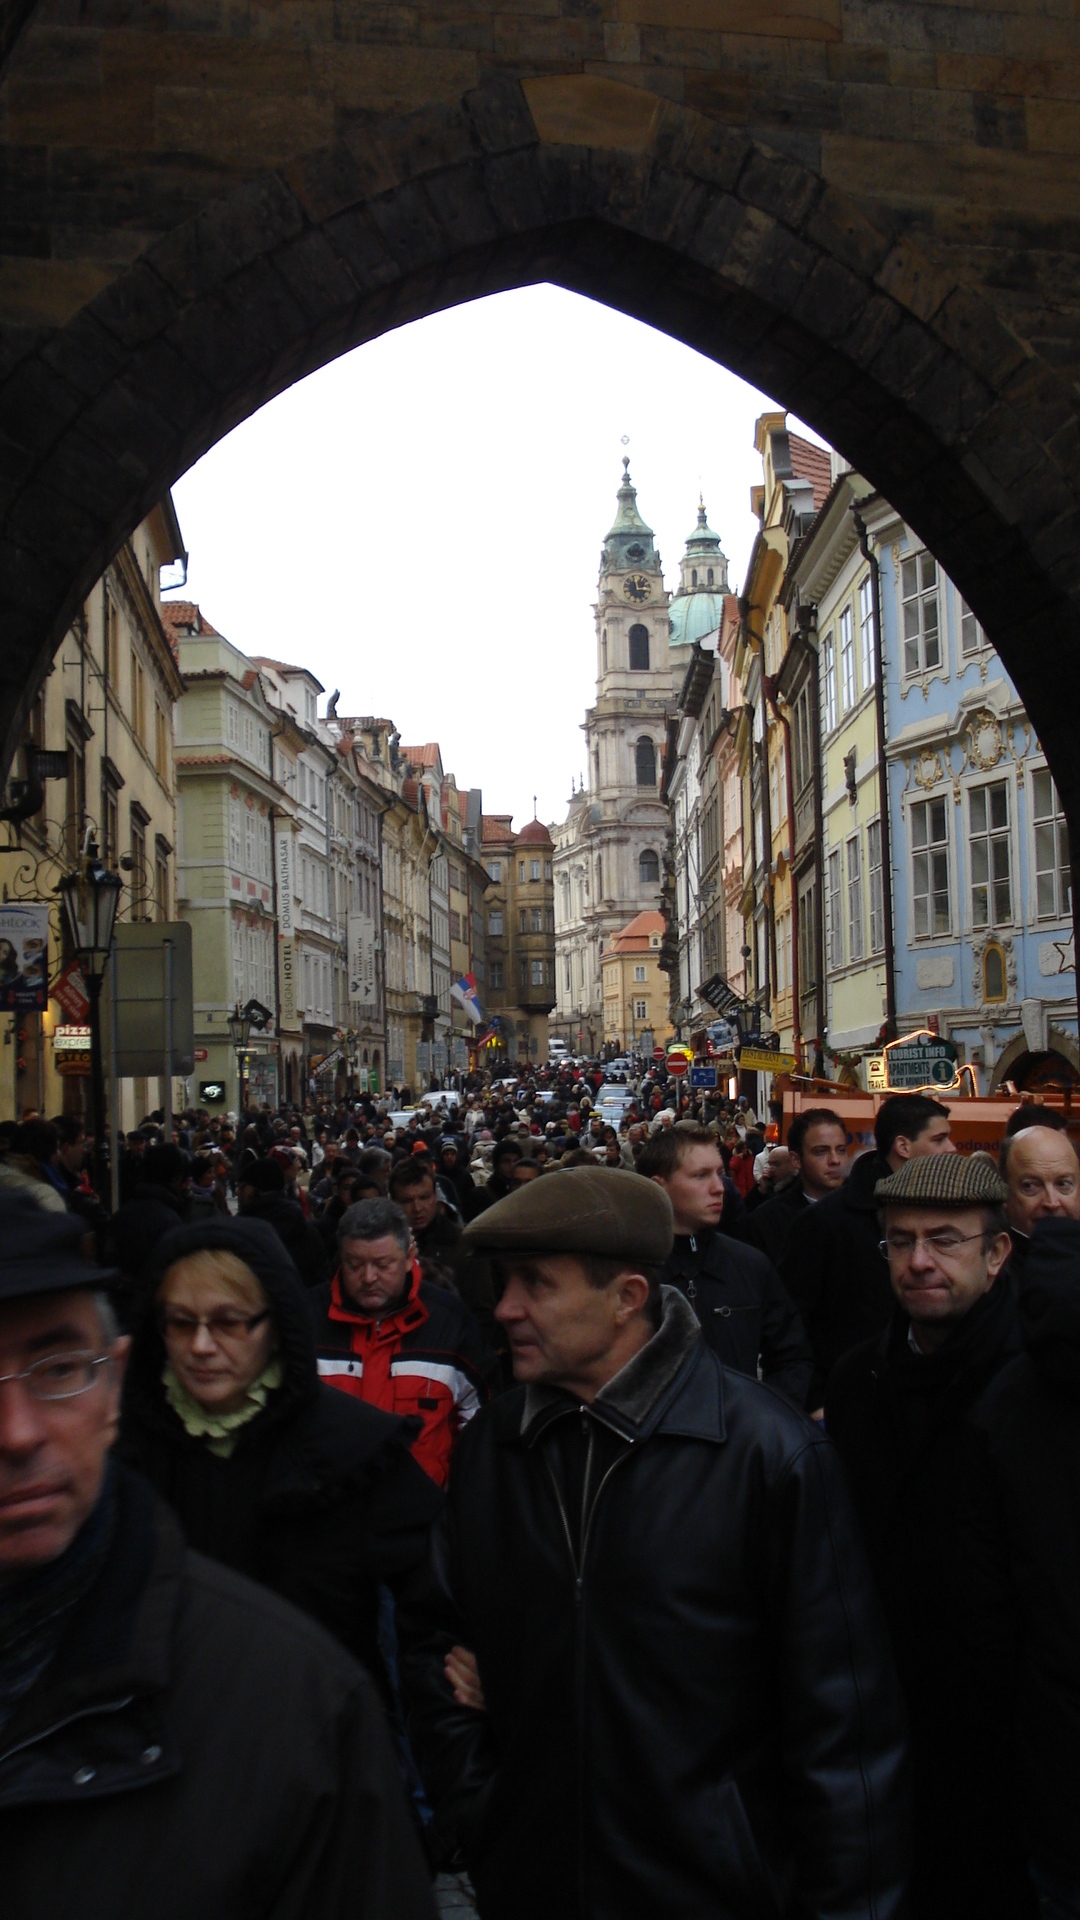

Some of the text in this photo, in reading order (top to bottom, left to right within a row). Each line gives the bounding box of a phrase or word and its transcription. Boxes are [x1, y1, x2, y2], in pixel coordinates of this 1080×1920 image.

[280, 838, 291, 929] DOMUS BALTHASAR
[283, 944, 293, 1020] DESIGN HOTEL
[57, 1053, 90, 1061] GYRO
[887, 1046, 946, 1060] TOURIST INFO
[889, 1061, 930, 1076] APARTMENTS
[867, 1079, 886, 1090] TRAVE
[905, 1076, 930, 1086] MINUTE
